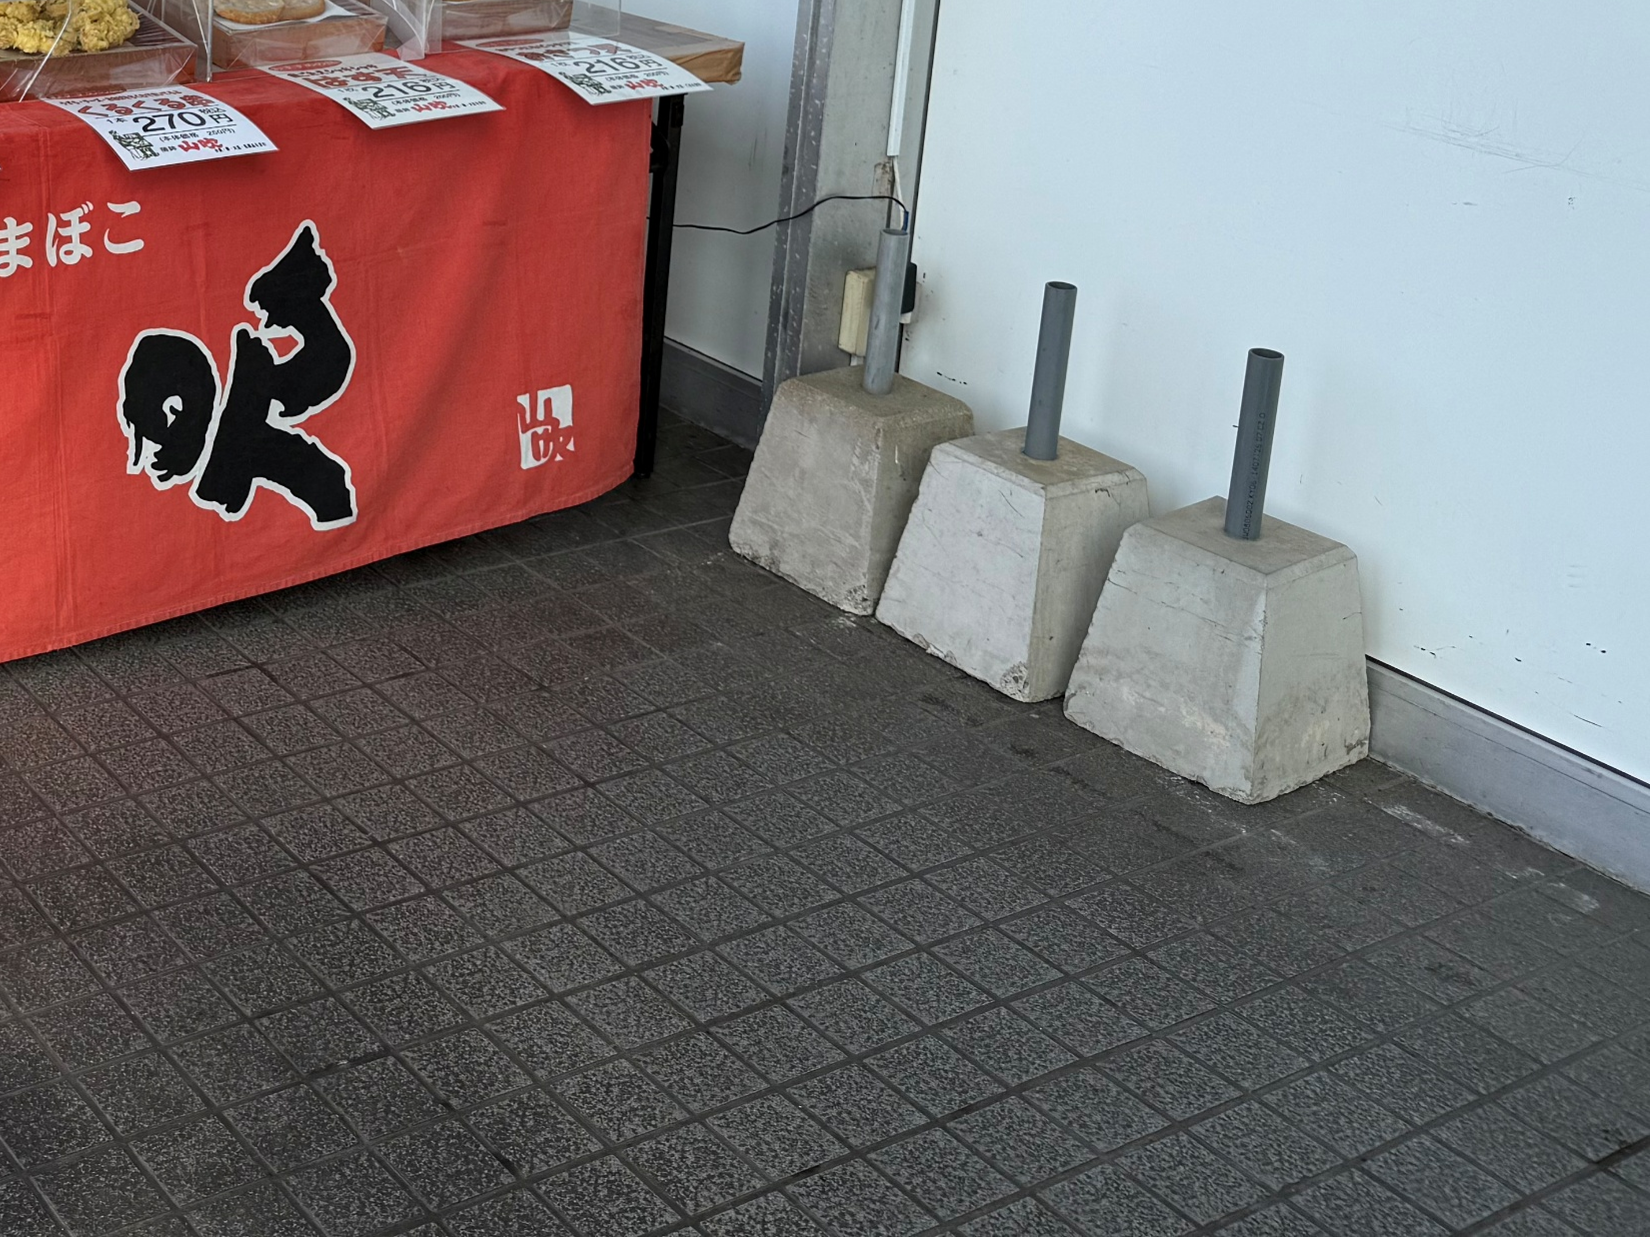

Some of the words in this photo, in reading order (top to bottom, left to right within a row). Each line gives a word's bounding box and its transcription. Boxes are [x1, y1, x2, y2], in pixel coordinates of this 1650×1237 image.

[574, 56, 641, 74] 216
[361, 81, 433, 99] 216
[133, 111, 208, 133] 270
[209, 113, 234, 124] 円
[178, 137, 224, 153] 山吹
